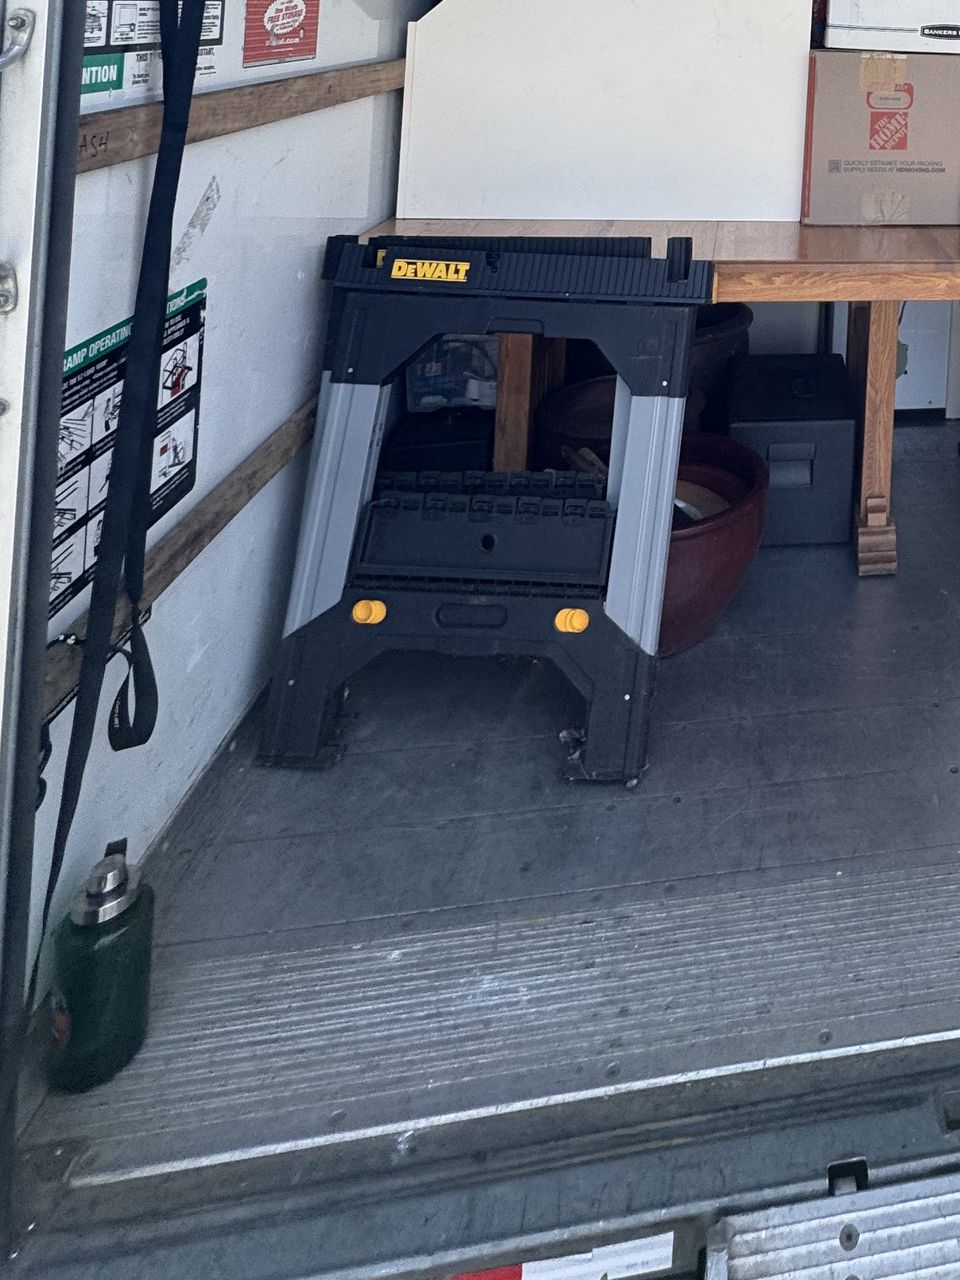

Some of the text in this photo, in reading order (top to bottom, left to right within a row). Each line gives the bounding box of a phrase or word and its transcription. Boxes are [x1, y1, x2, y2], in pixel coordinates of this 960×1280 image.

[281, 9, 304, 20] STORAGE
[870, 112, 908, 150] HOME
[875, 116, 889, 131] THE
[885, 126, 908, 150] DEPOT
